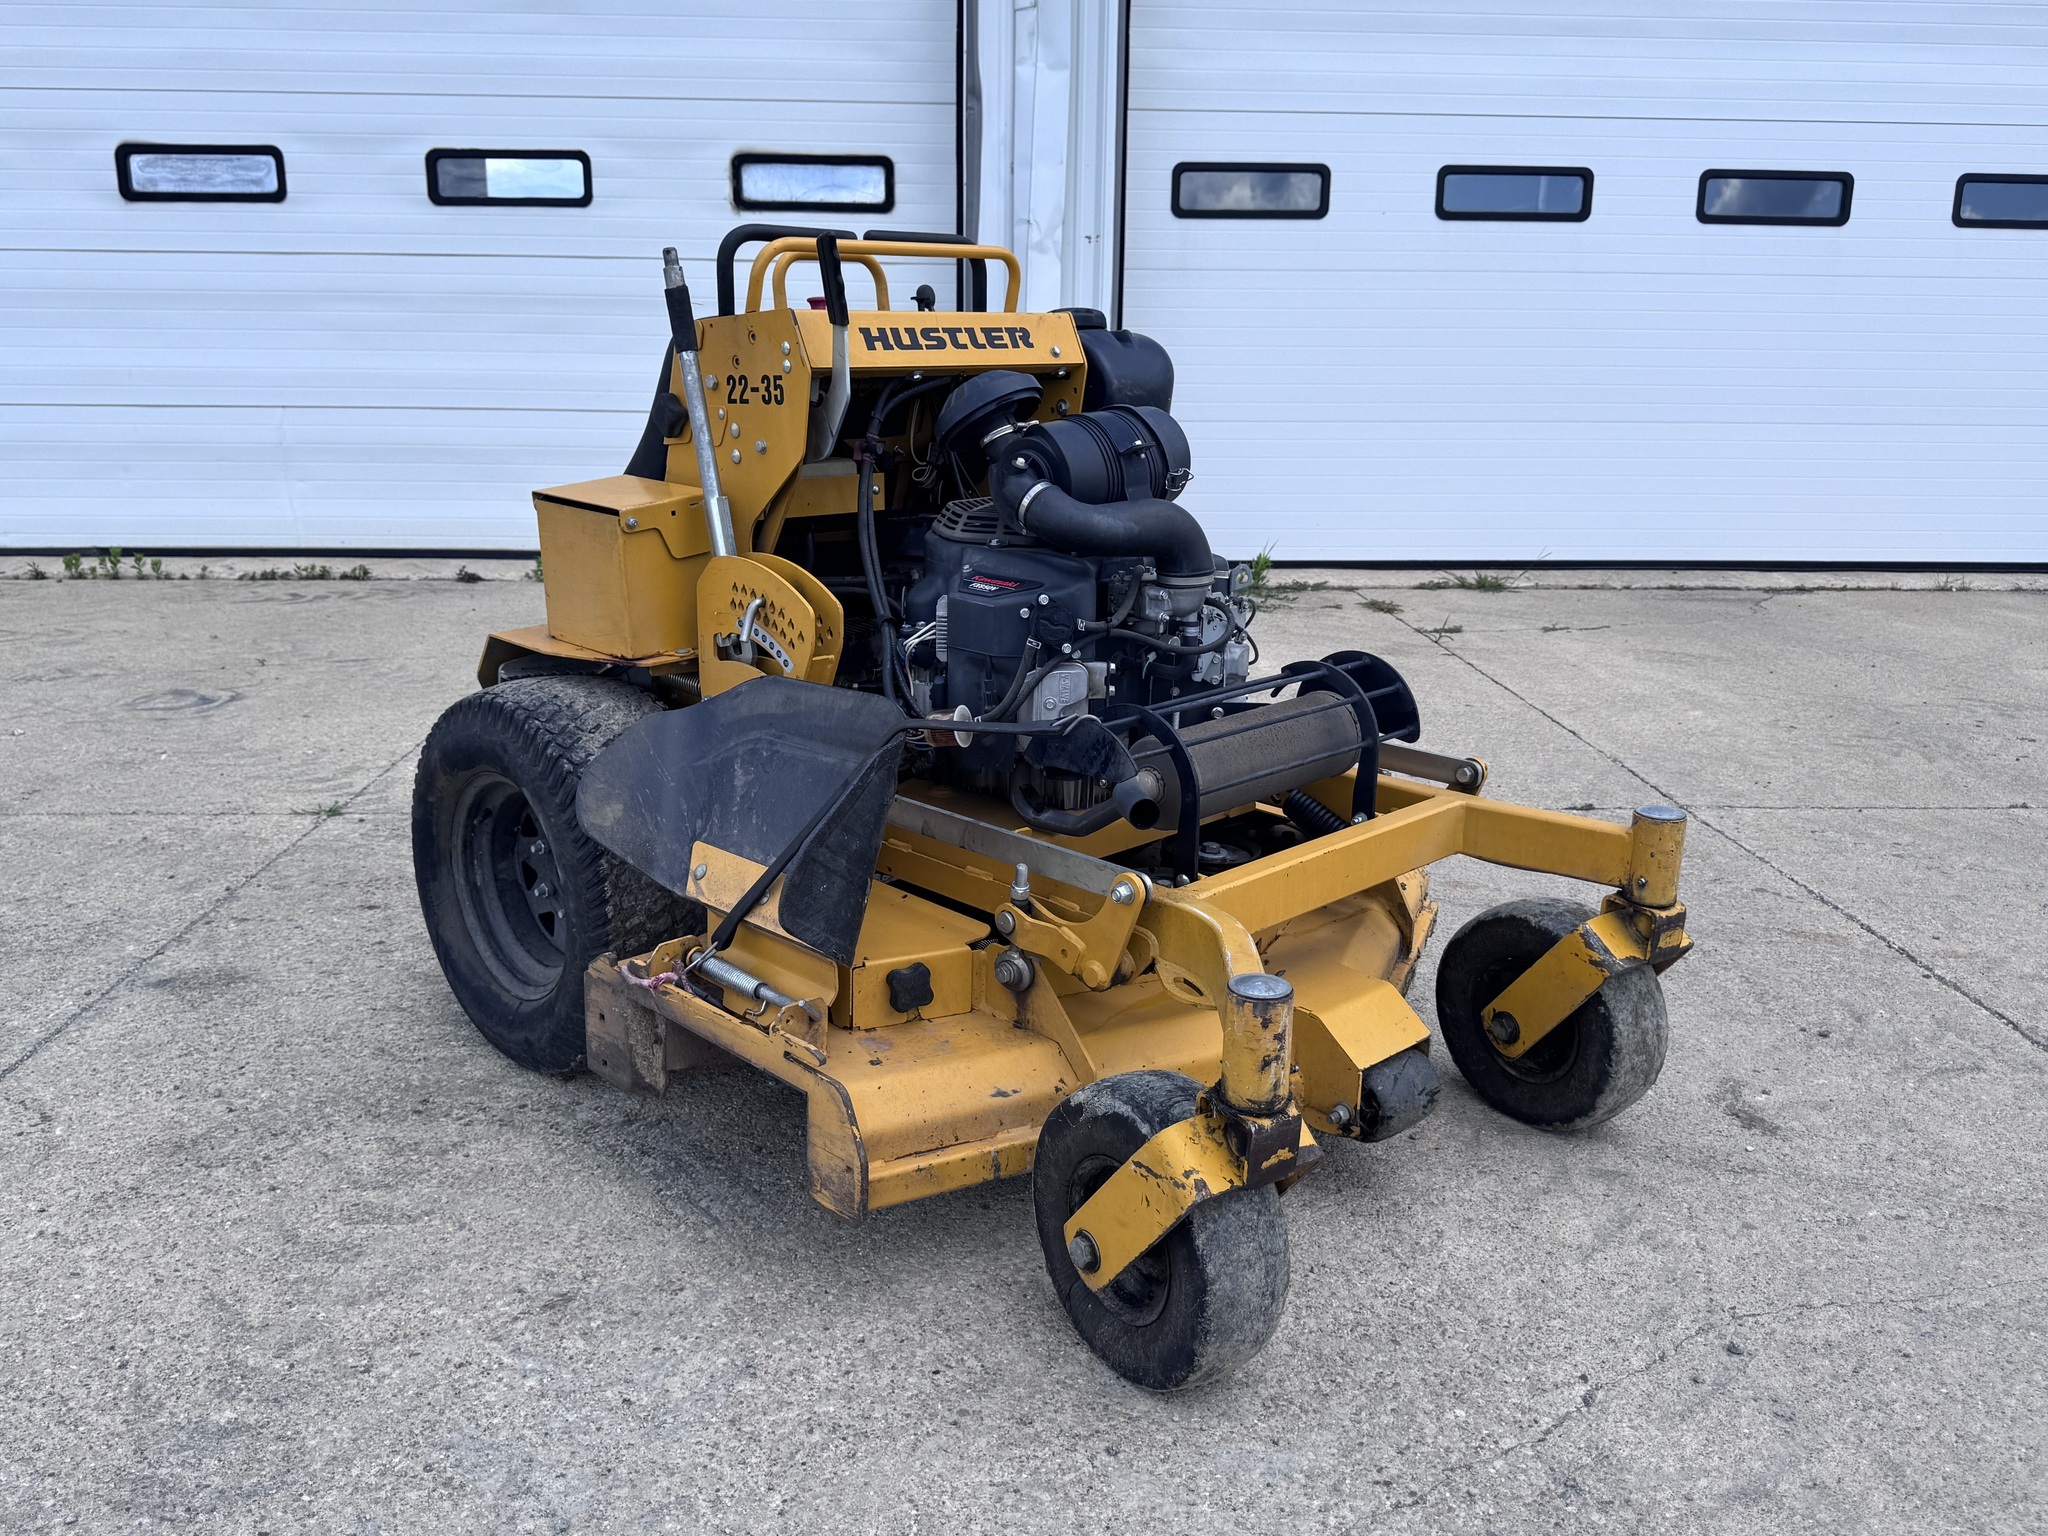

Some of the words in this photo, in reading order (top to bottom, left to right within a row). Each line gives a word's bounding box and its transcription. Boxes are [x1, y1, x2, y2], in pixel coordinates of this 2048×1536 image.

[858, 327, 1034, 351] HUSTLER
[726, 374, 785, 406] 22-35
[971, 575, 1020, 588] Kawasaki
